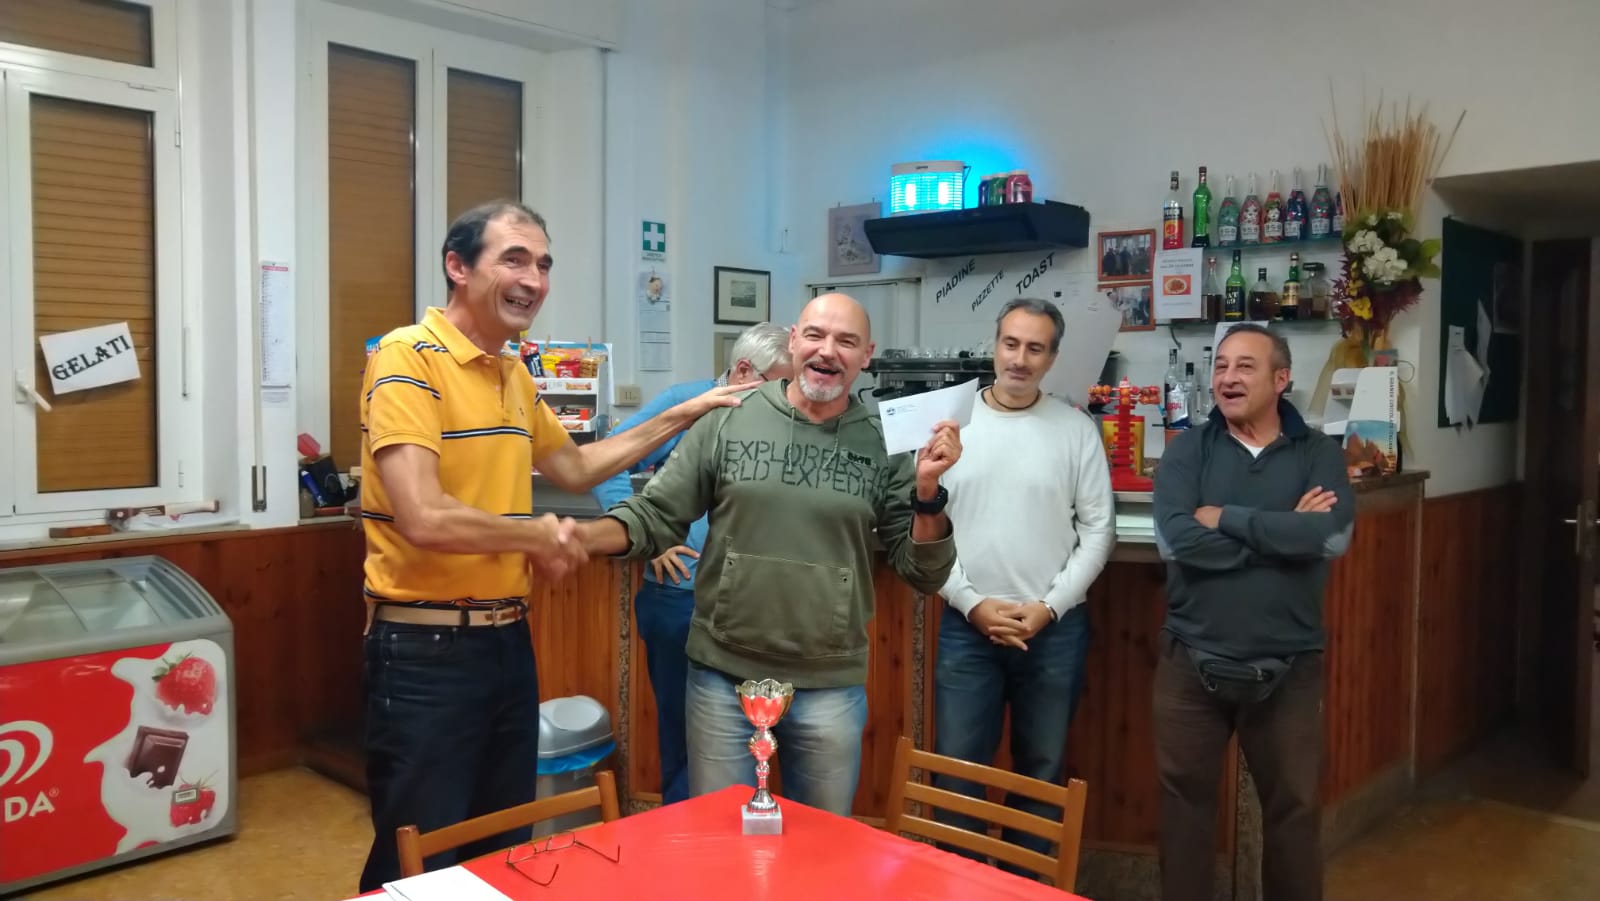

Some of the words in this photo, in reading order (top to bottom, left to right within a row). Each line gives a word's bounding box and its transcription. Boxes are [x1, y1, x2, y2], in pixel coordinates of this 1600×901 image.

[936, 258, 976, 303] PIADINE
[971, 269, 1004, 312] PIZZETTE
[1016, 252, 1056, 295] TOAST
[51, 335, 131, 380] GELATI
